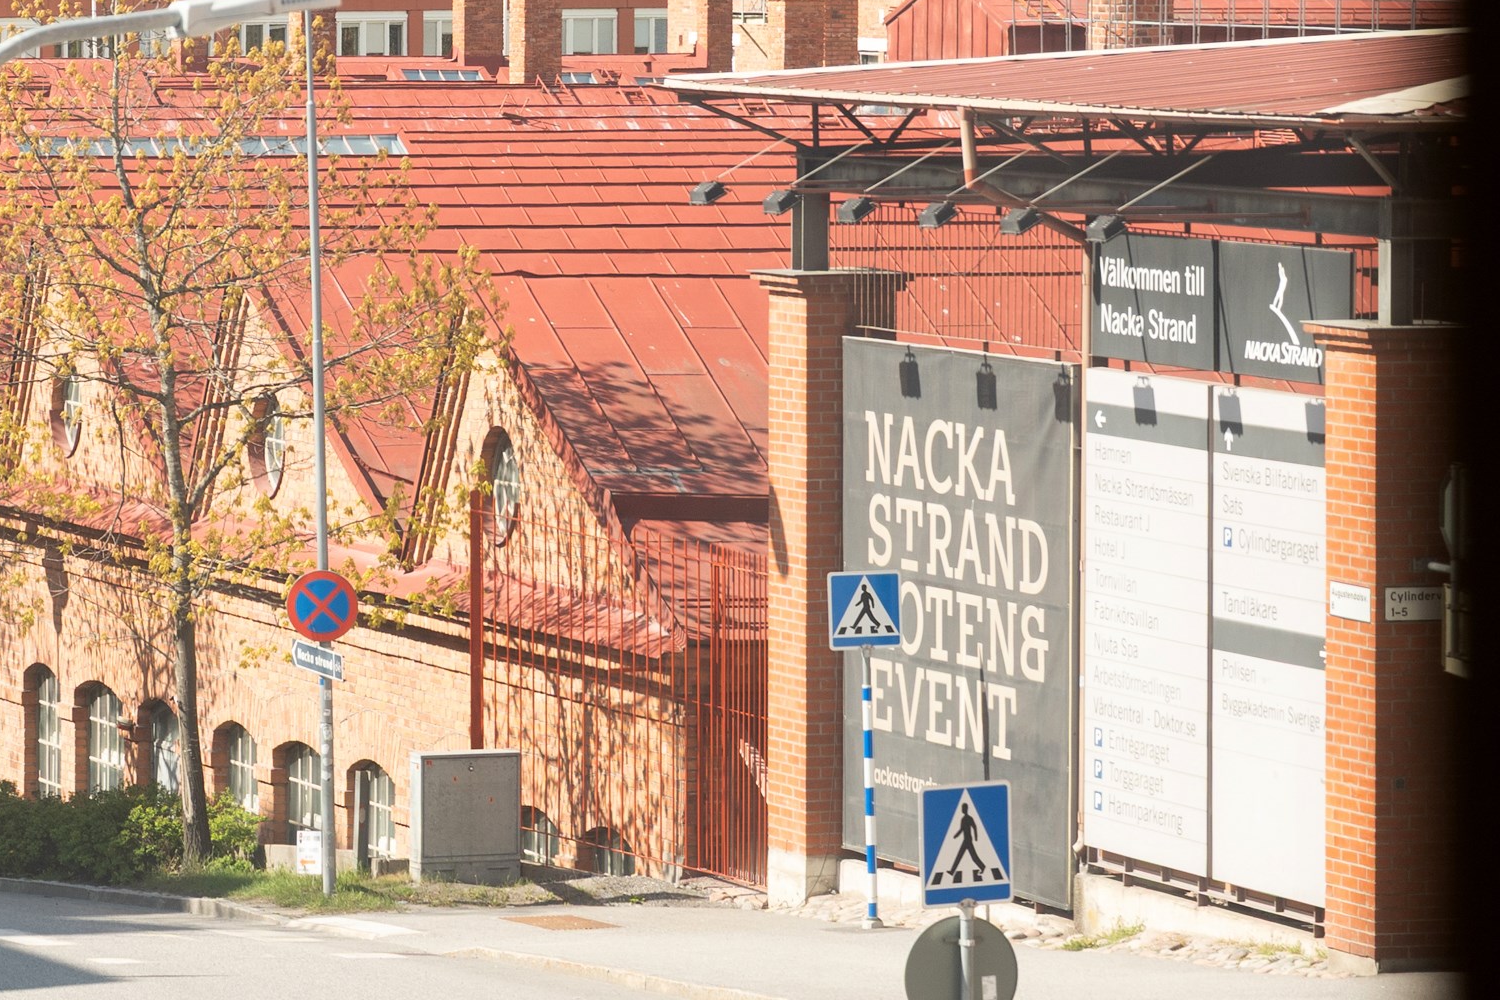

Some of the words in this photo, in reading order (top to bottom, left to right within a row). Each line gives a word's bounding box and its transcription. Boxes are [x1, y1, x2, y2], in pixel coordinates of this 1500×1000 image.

[1100, 256, 1181, 294] Välkommen
[1184, 265, 1205, 297] till
[1101, 303, 1144, 337] Nacka
[1148, 308, 1197, 345] Strand
[865, 409, 1016, 506] NACKA
[1094, 441, 1132, 464] Hamnen
[1094, 473, 1122, 494] Nacka
[1124, 477, 1194, 507] Strandsmässan
[1222, 461, 1261, 485] Svenska
[1265, 467, 1318, 493] Bilfabriken
[1094, 504, 1142, 531] Restaurant
[1145, 513, 1150, 532] J
[1222, 494, 1244, 516] Sats
[868, 493, 1049, 595] STRAND
[1094, 536, 1118, 557] Hotel
[1120, 540, 1126, 560] J
[1238, 528, 1320, 564] Cylindergaraget
[1094, 568, 1137, 594] Tornvillan
[1093, 599, 1160, 631] Fabrikörsvillan
[1222, 591, 1278, 621] Tandläkare
[1391, 607, 1408, 617] 1-5
[1093, 632, 1118, 656] Njuta
[1121, 638, 1139, 661] Spa
[1093, 665, 1182, 703] Arbetsförmedlingen
[1222, 658, 1256, 684] Polisen
[870, 657, 1017, 761] EVENT
[1093, 696, 1145, 724] Vårdcentral
[1153, 709, 1197, 738] Doktor.se
[1221, 692, 1285, 722] Byggakademin
[1287, 706, 1321, 733] Sverige
[1108, 760, 1164, 796] Torggaraget
[1108, 793, 1184, 836] Hamnparkering
